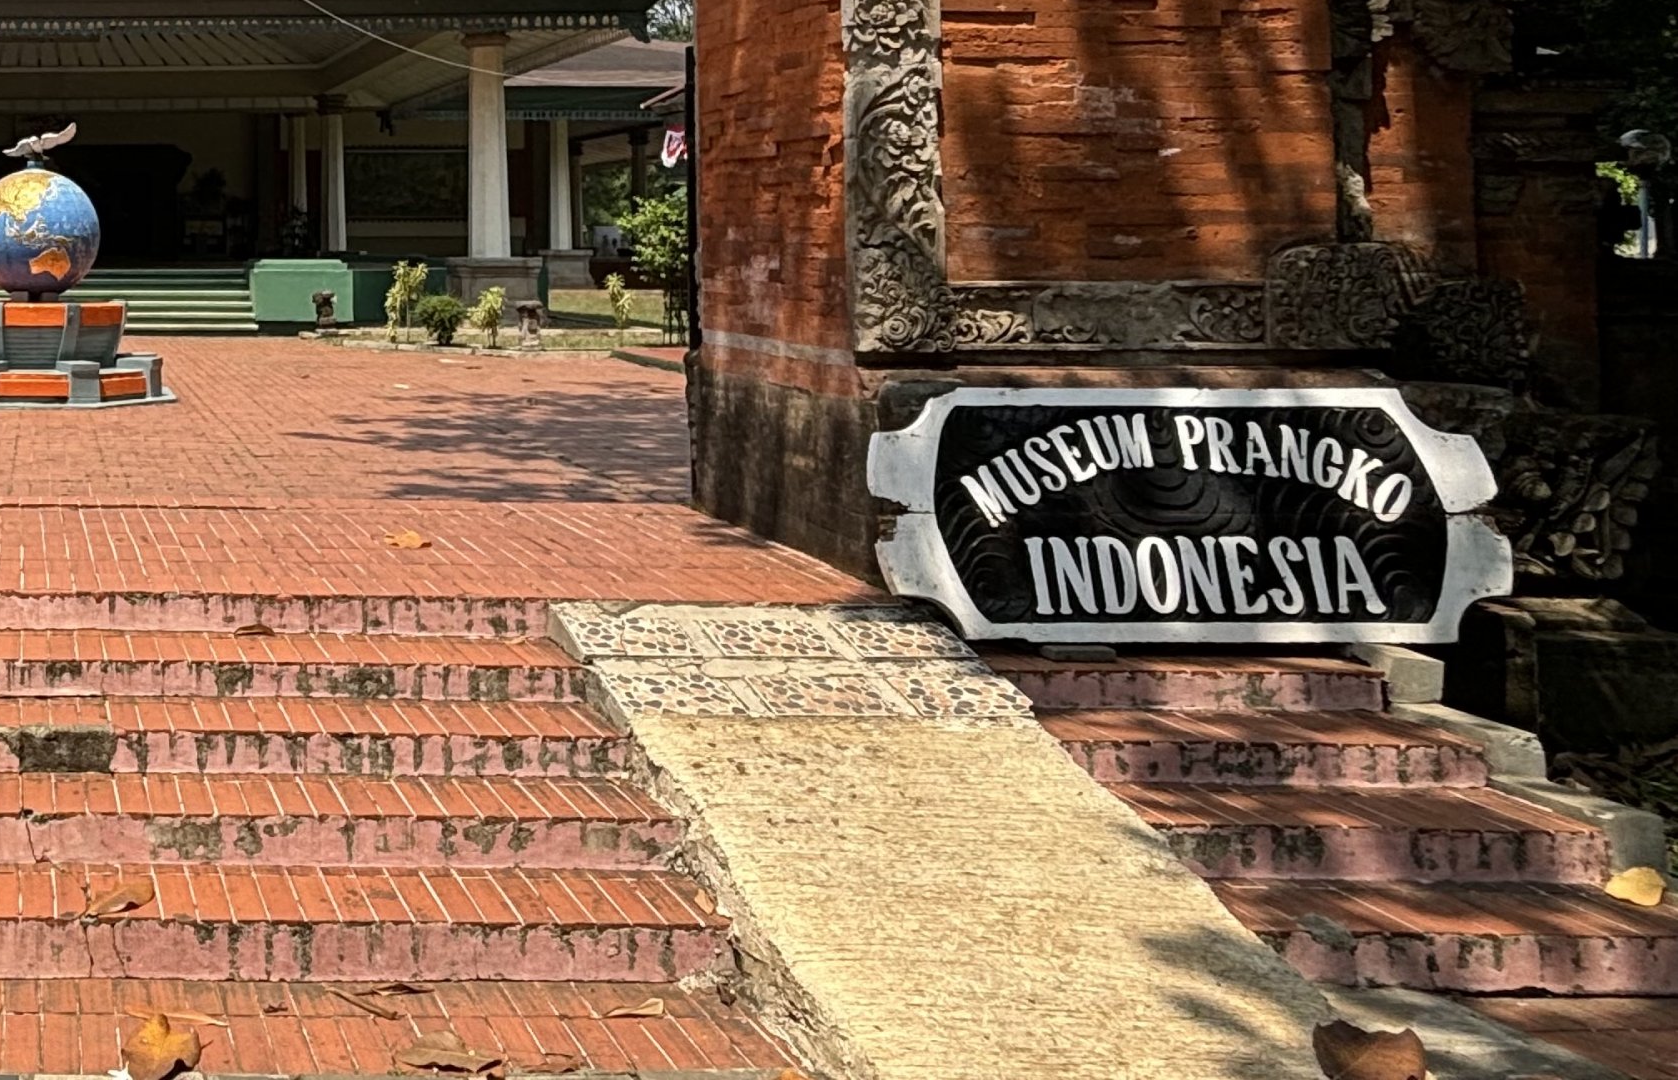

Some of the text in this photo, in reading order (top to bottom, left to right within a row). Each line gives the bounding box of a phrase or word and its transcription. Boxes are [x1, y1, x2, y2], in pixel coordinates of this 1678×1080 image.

[960, 413, 1413, 528] MUSEUM PRANGKO
[1024, 535, 1386, 615] INDONESIA
